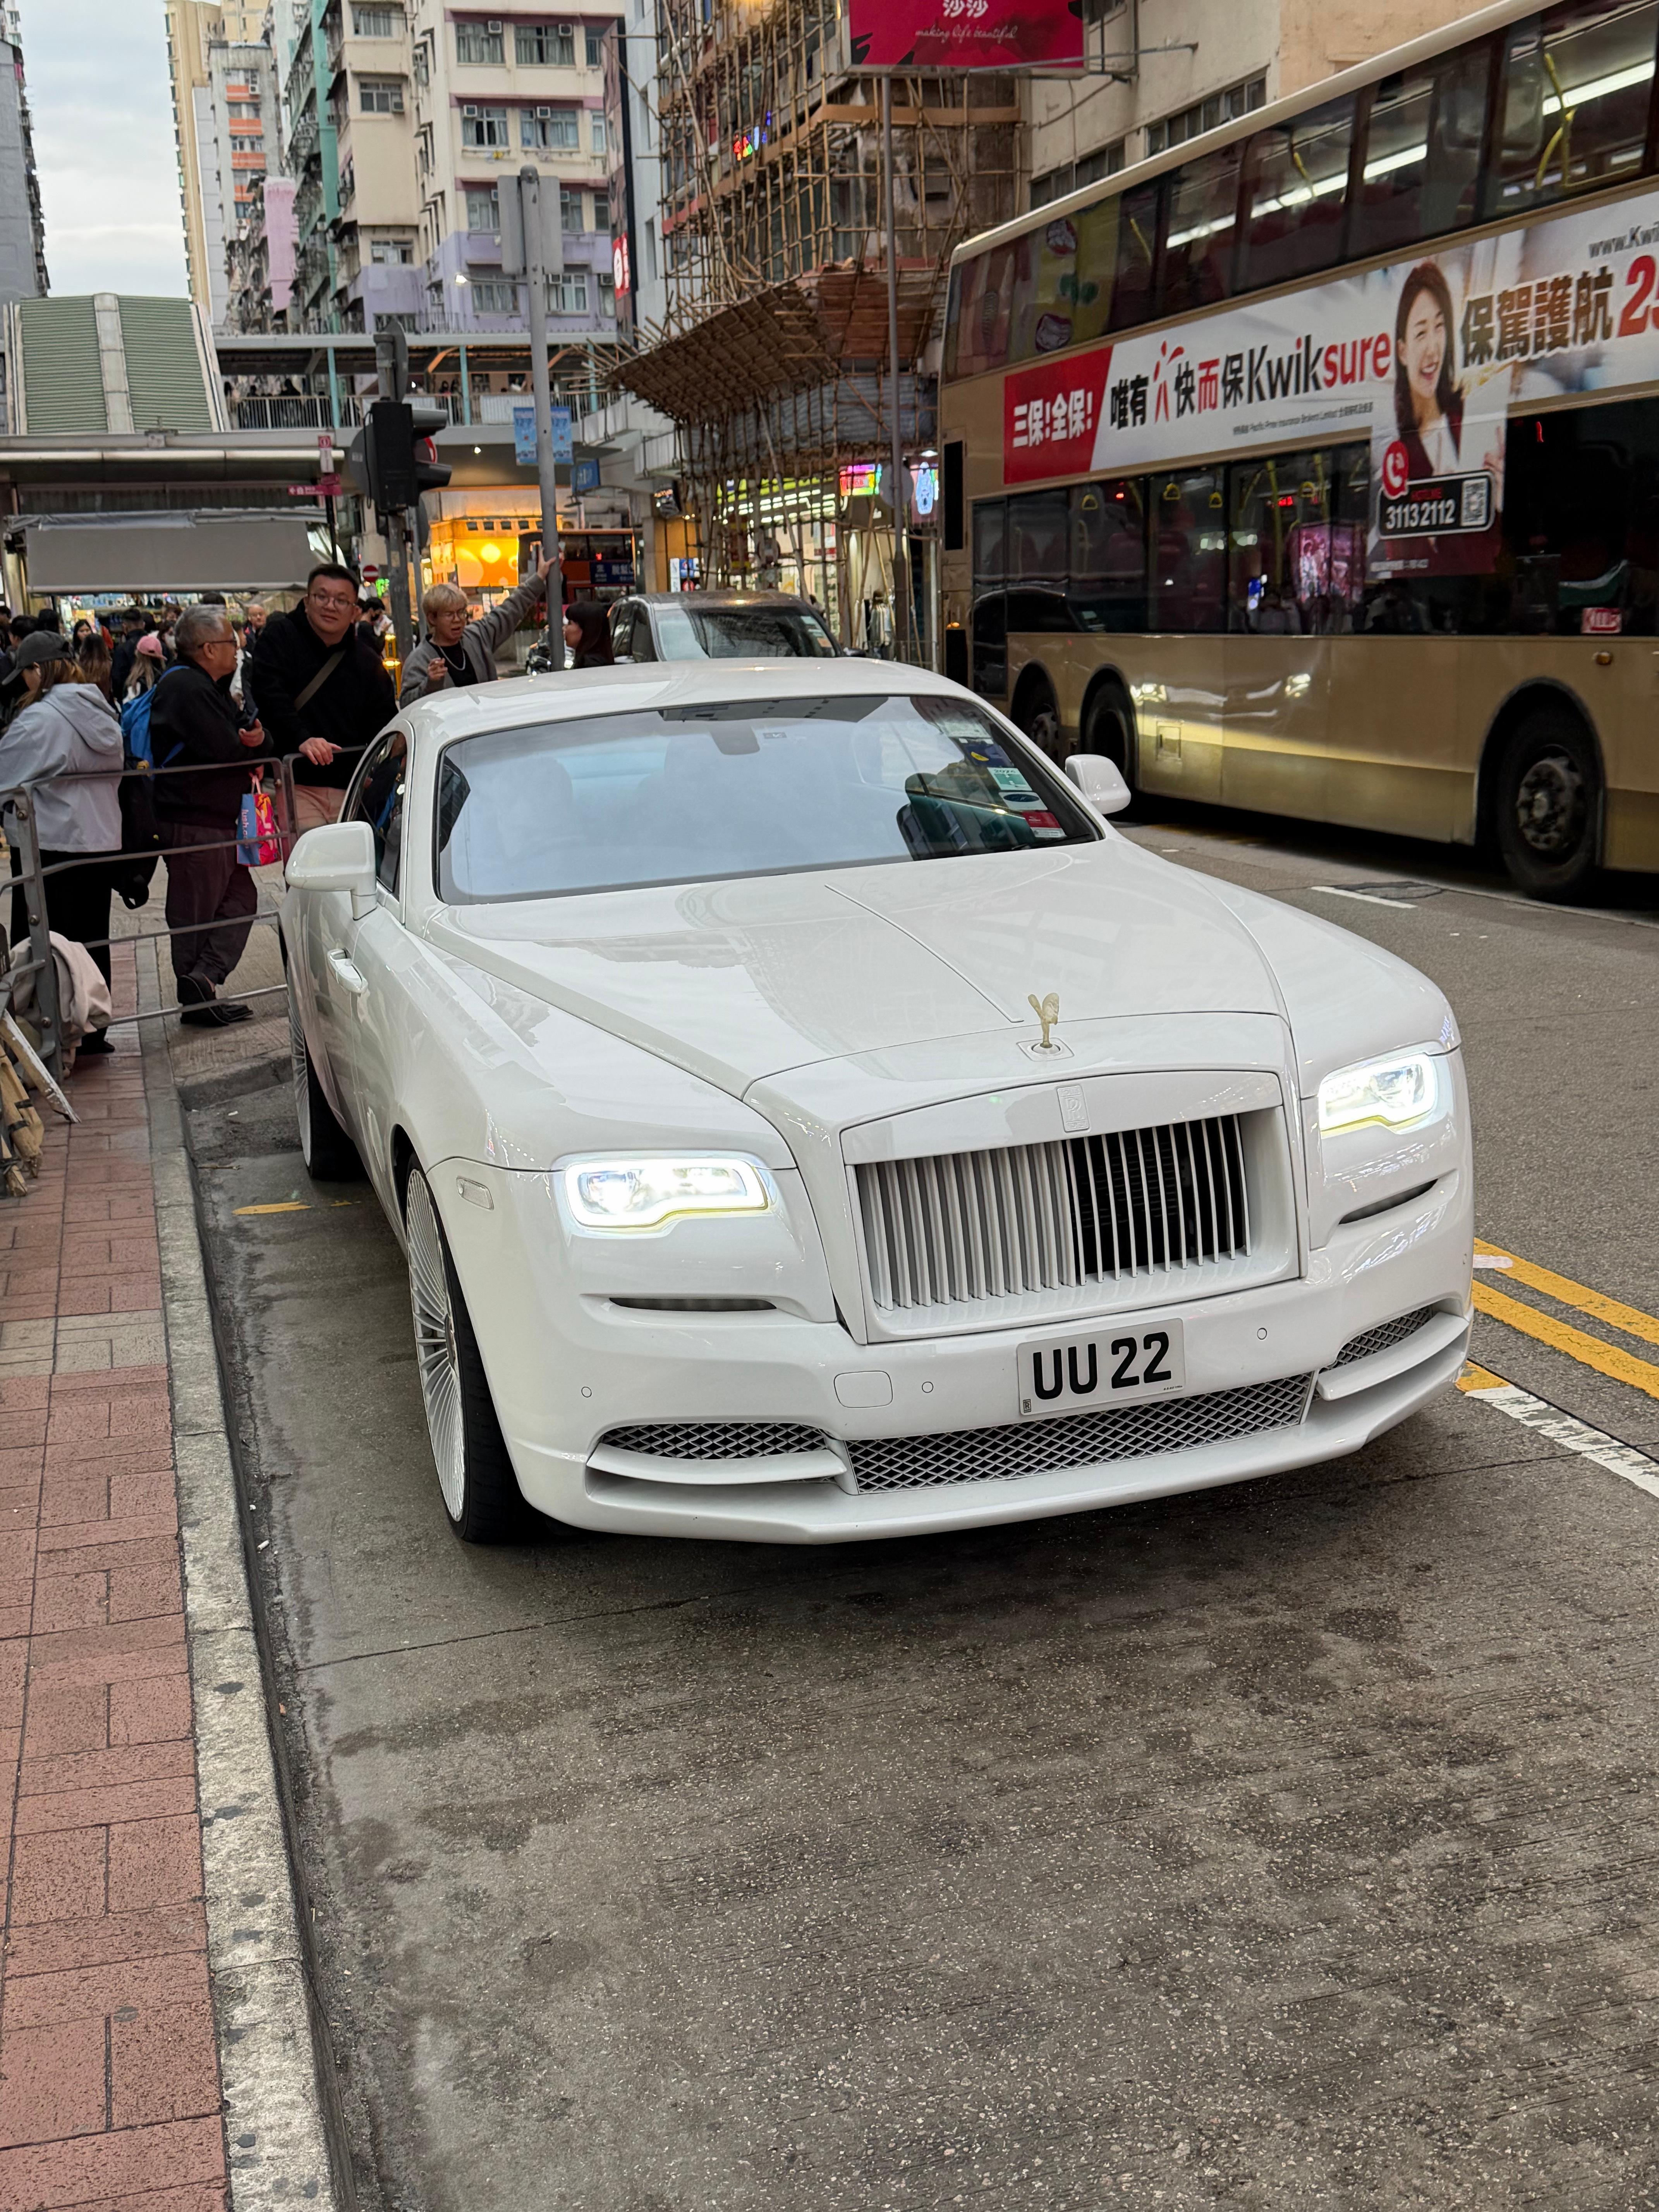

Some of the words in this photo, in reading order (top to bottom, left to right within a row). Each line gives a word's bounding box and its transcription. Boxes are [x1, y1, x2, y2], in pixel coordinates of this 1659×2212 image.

[915, 23, 950, 43] making
[952, 24, 971, 43] life
[973, 24, 1018, 44] beautiful
[1462, 266, 1613, 368] 保駕護航
[1247, 332, 1391, 404] Kwiksure
[1033, 1343, 1097, 1400] UU
[1111, 1332, 1171, 1389] 22
